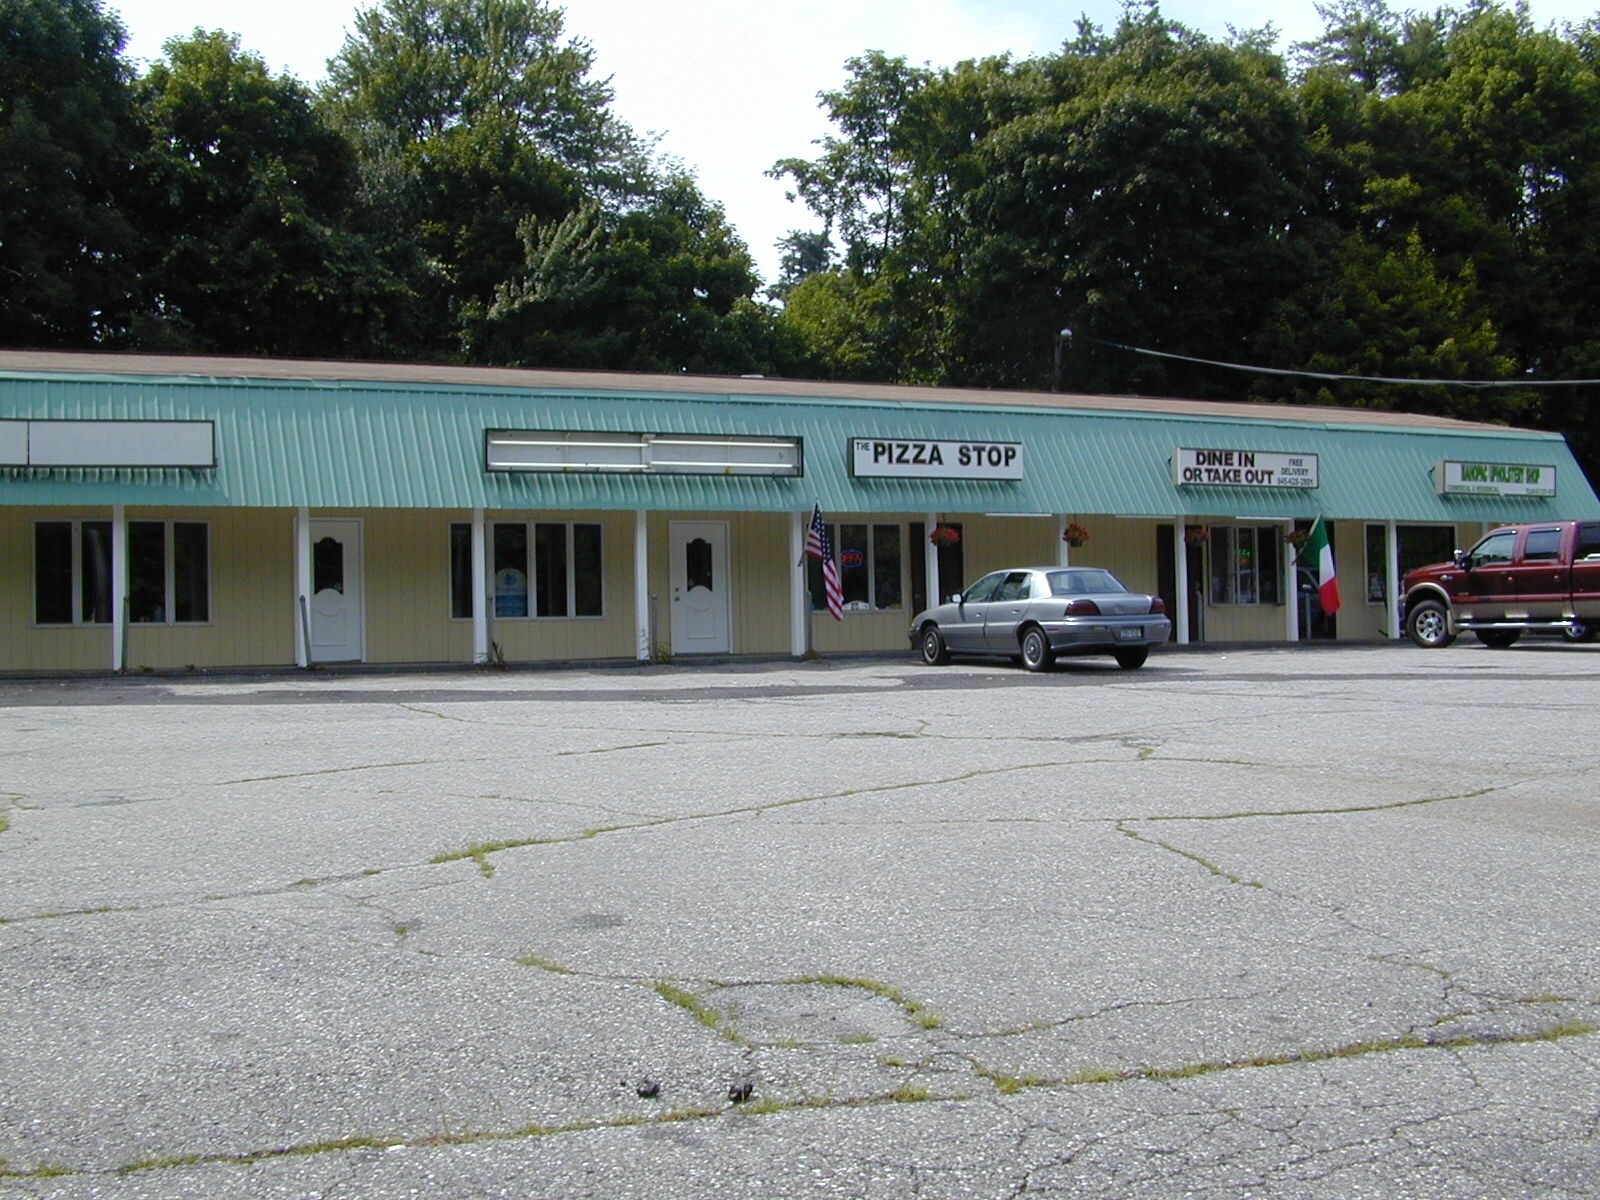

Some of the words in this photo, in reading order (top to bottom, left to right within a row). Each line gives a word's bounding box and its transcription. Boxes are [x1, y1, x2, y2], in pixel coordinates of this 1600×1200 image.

[856, 442, 870, 450] THE
[873, 442, 944, 465] PIZZA
[958, 445, 1016, 467] STOP
[1196, 451, 1234, 466] DINE
[1238, 452, 1255, 467] IN
[1288, 458, 1304, 467] FREE
[1183, 467, 1203, 482] OR
[1205, 468, 1242, 483] TAKE
[1245, 469, 1275, 484] OUT
[1281, 467, 1309, 476] DELIVERY
